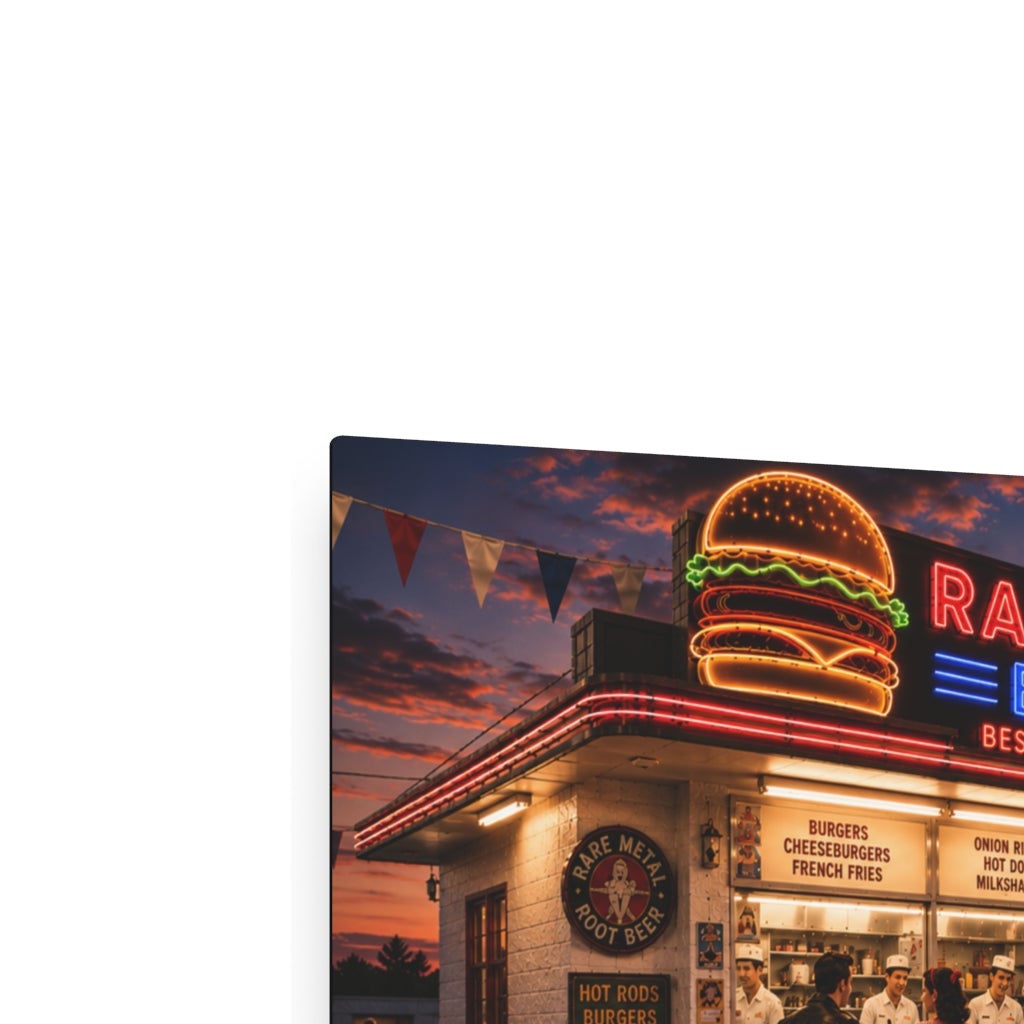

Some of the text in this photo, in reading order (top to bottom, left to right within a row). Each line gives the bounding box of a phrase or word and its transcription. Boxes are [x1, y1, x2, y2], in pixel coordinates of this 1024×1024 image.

[809, 819, 869, 841] BURGERS
[783, 837, 891, 863] CHEESEBURGERS
[974, 836, 1010, 855] ONION
[572, 834, 666, 887] RARE METAL
[792, 859, 883, 882] FRENCH FRIES
[983, 856, 1005, 872] HOT
[575, 903, 665, 945] ROOT BEER
[579, 984, 660, 1002] HOT RODS
